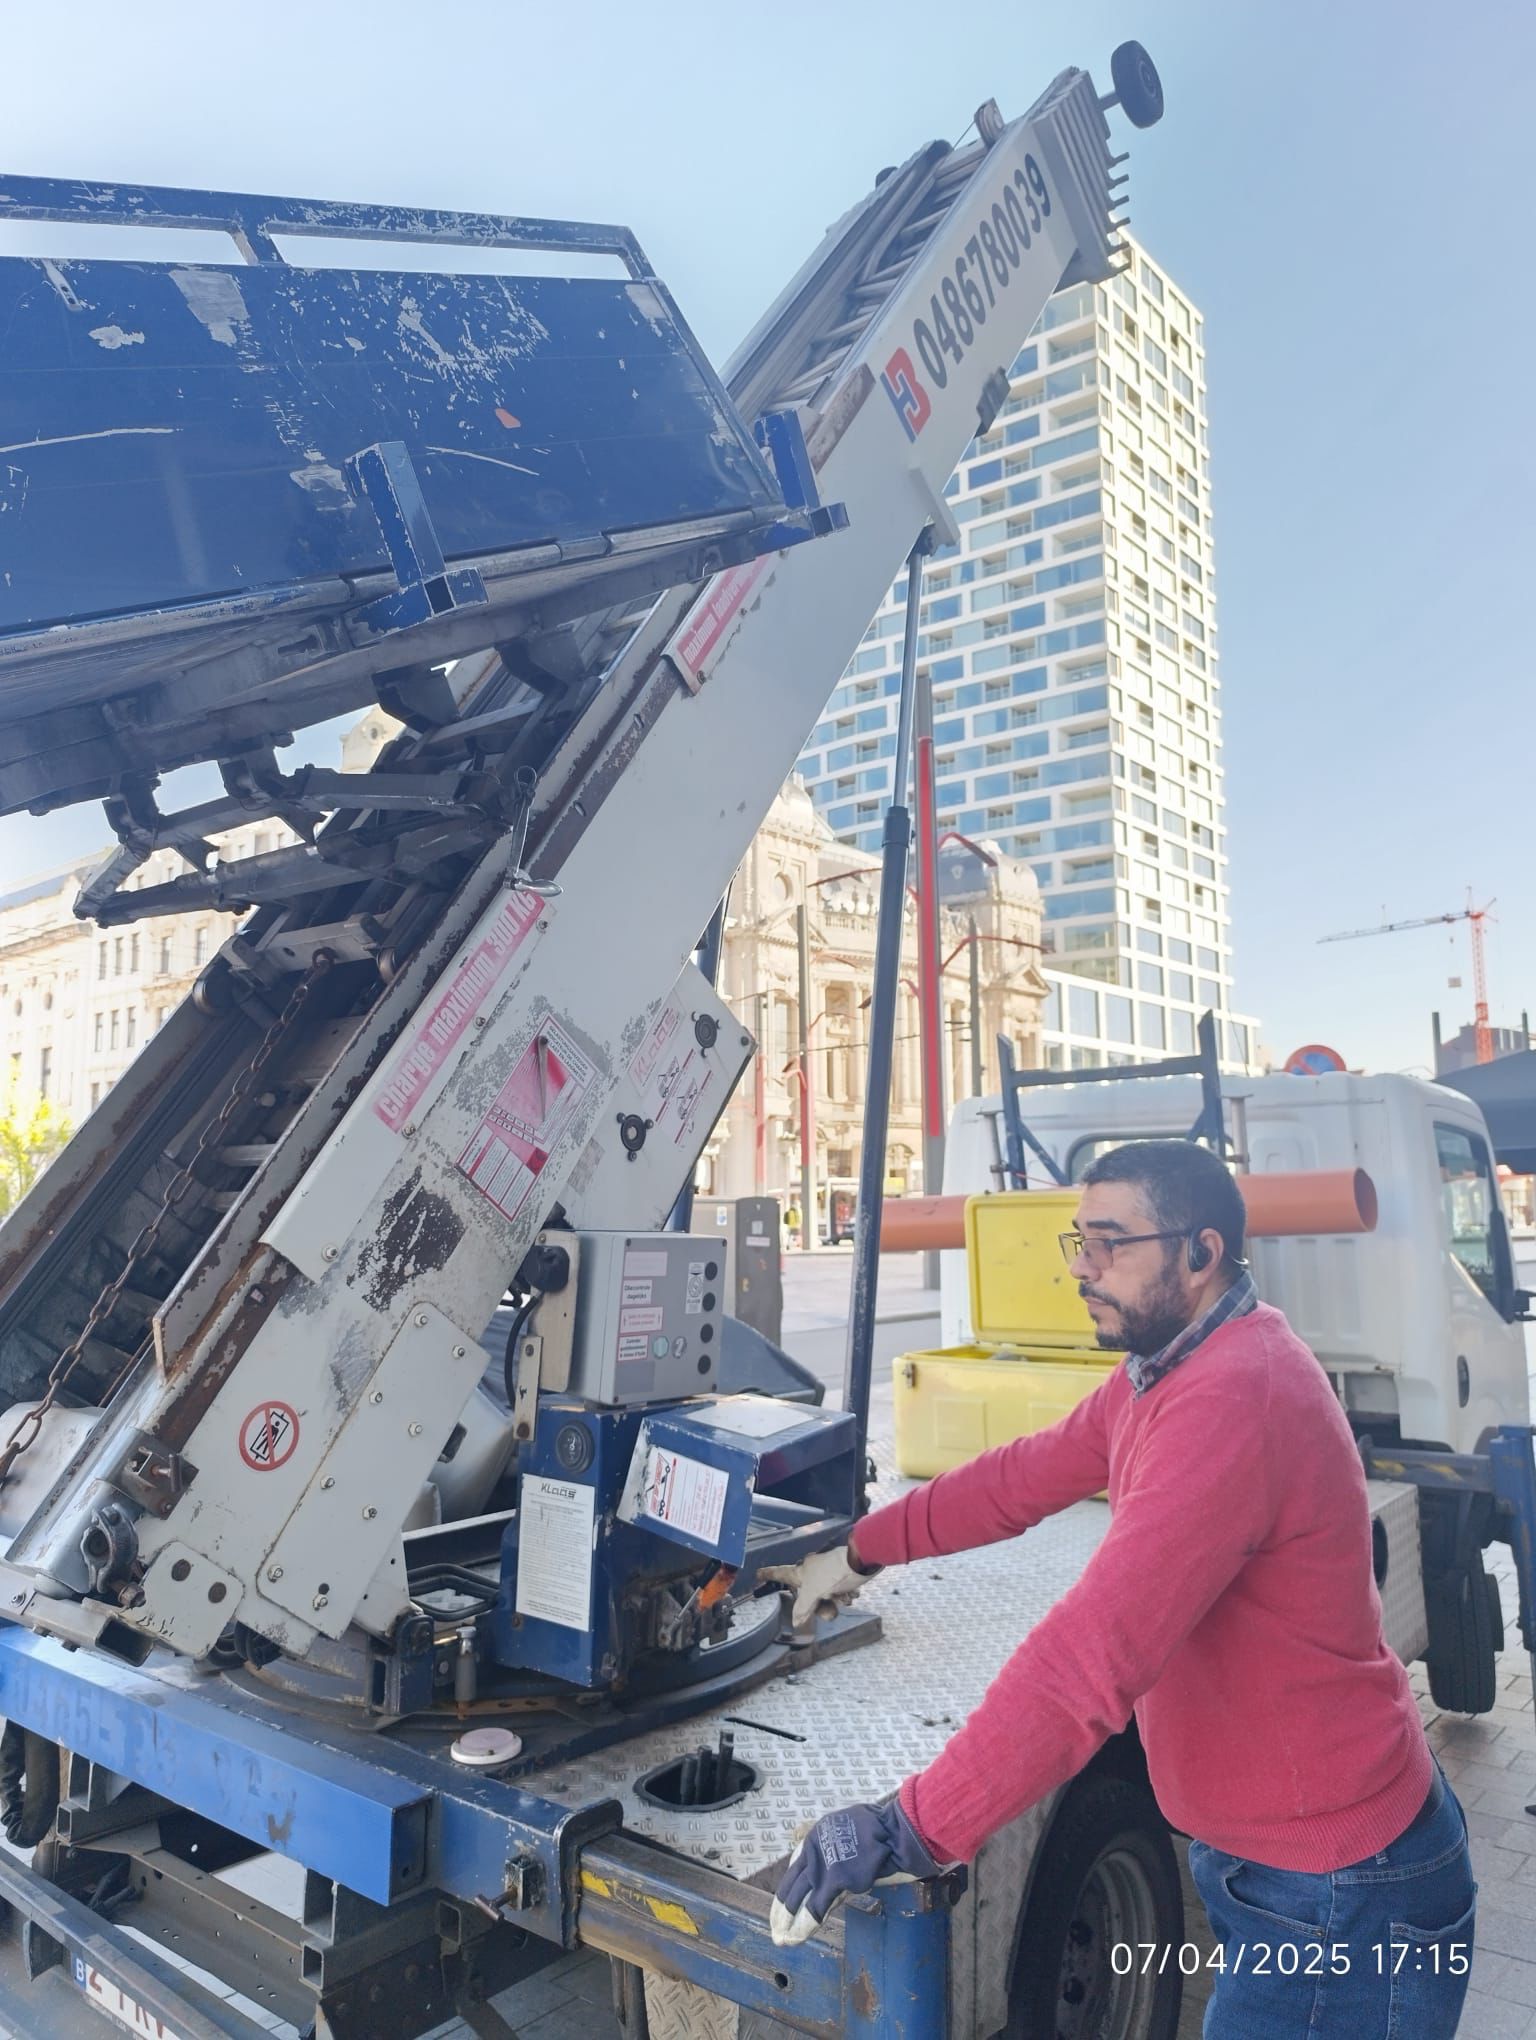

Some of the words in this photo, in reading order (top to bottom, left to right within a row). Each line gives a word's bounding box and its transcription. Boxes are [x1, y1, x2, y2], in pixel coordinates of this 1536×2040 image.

[913, 153, 1052, 389] 0486780039
[377, 1040, 437, 1121] Charge
[429, 950, 495, 1046] maximum
[487, 910, 521, 955] 300
[76, 1957, 85, 1983] B
